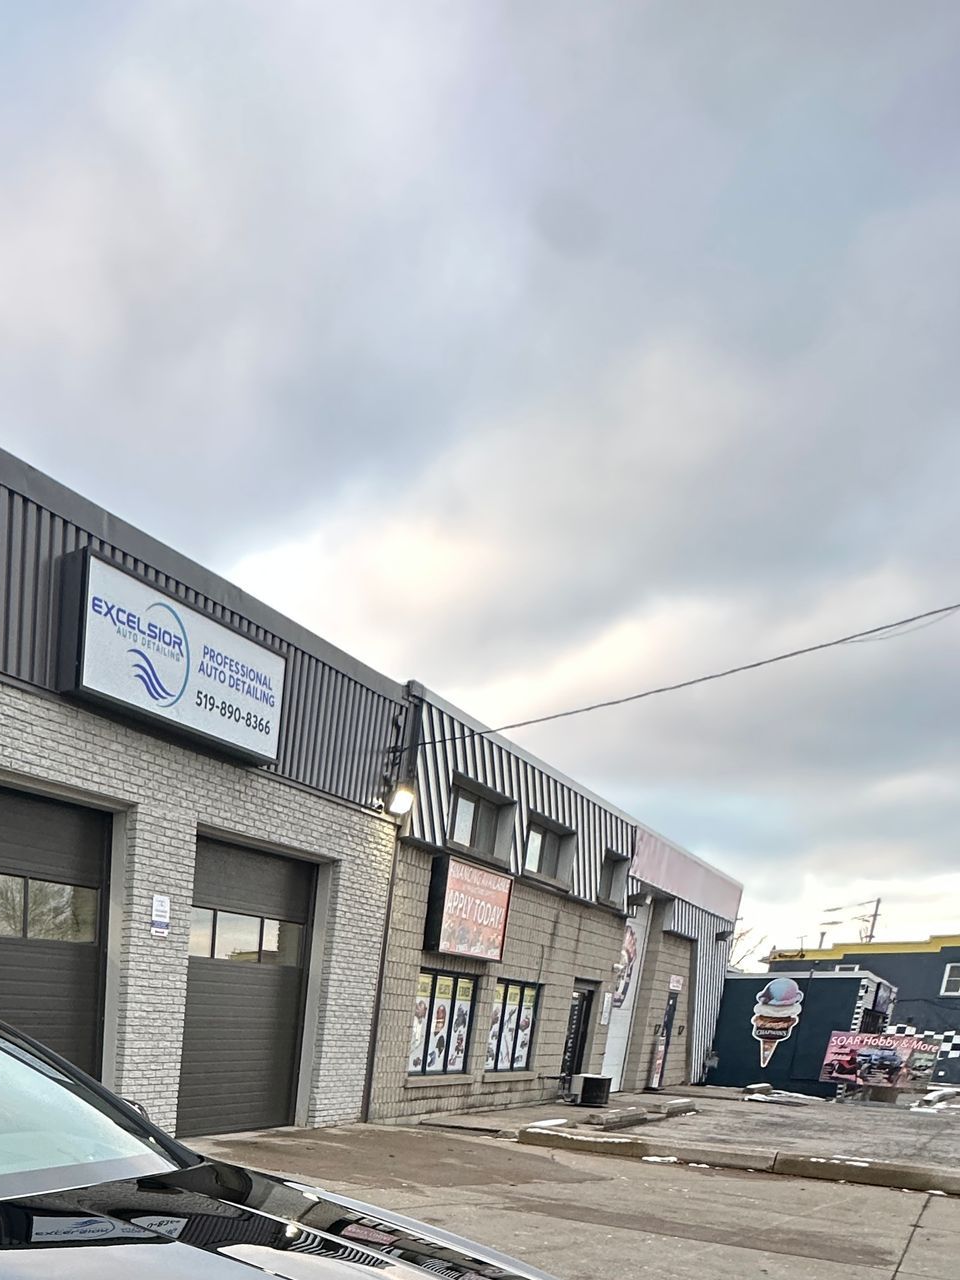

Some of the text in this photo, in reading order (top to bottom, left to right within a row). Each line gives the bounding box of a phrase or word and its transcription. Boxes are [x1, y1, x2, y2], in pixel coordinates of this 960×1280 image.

[91, 596, 184, 657] EXCELSIOR
[116, 626, 181, 662] AUTO DETAILING
[198, 660, 275, 708] AUTO DETAILING
[203, 645, 273, 691] PROFESSIONAL
[195, 691, 271, 735] 519-890-8366
[445, 889, 474, 919] APPLY
[474, 899, 505, 929] TODAY!
[831, 1036, 939, 1053] SOAR Hobby & More
